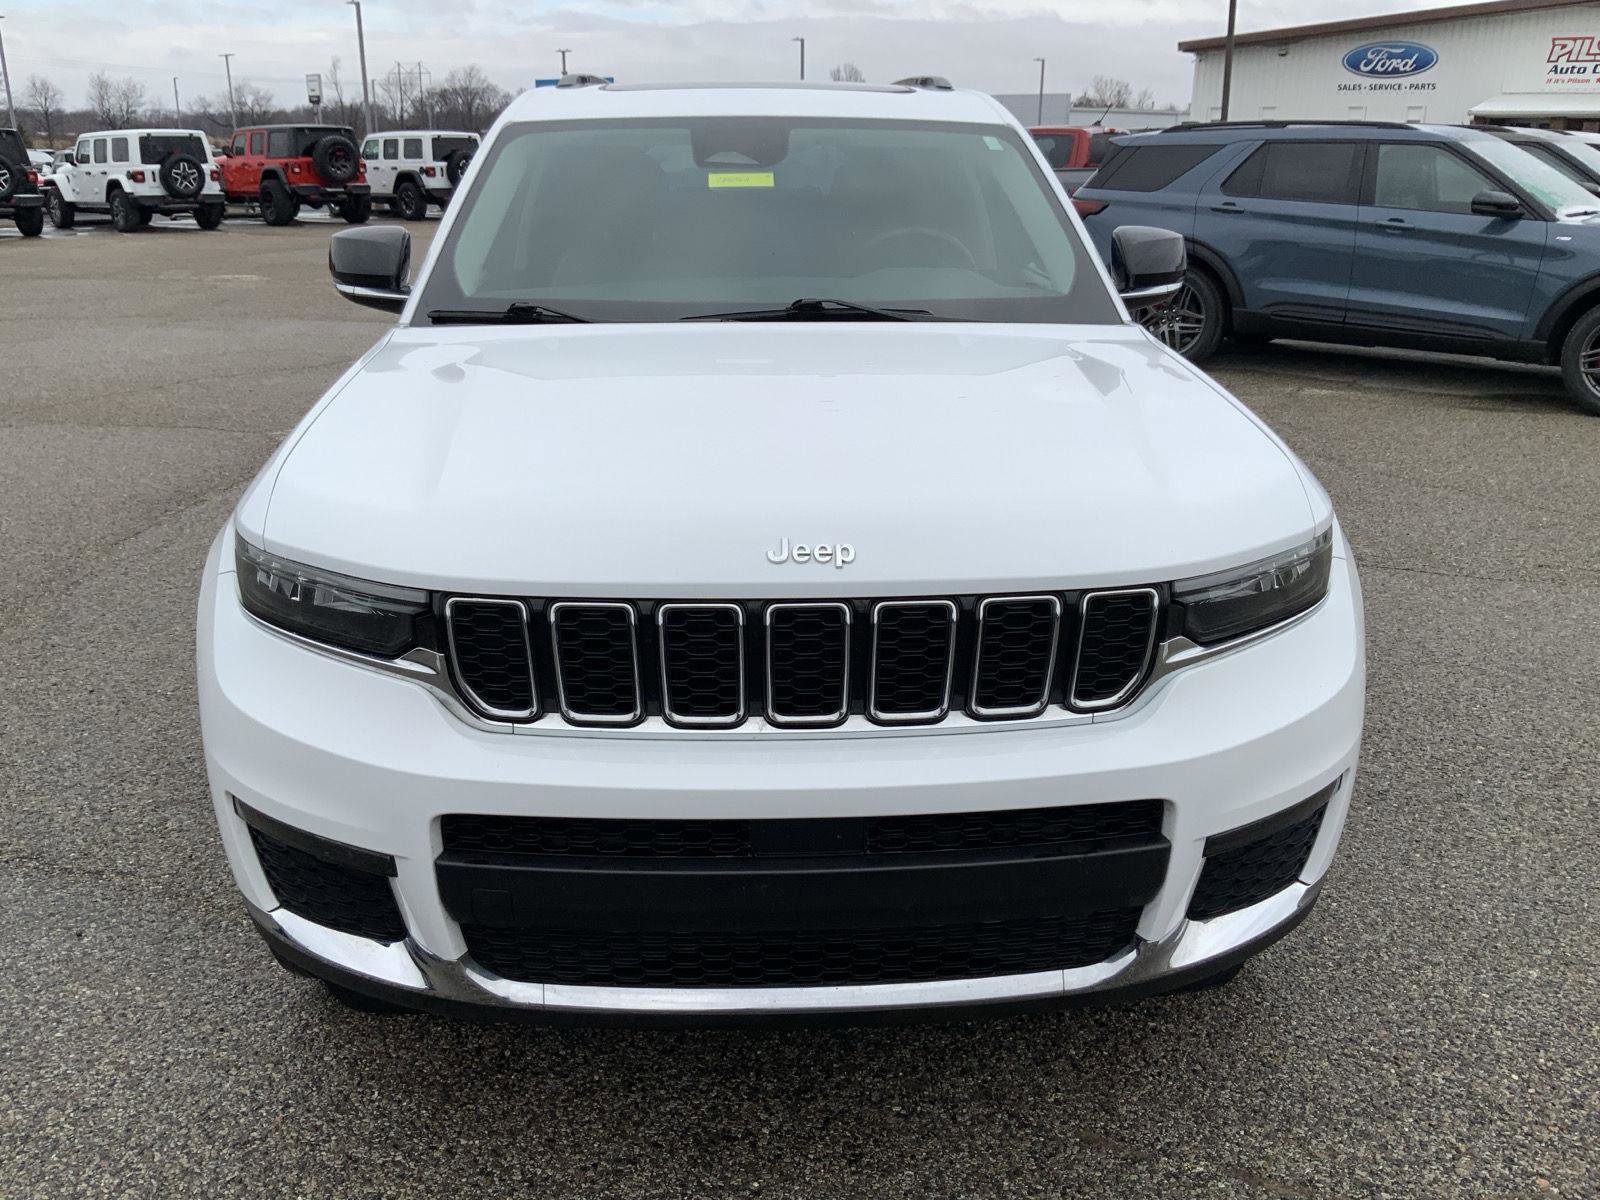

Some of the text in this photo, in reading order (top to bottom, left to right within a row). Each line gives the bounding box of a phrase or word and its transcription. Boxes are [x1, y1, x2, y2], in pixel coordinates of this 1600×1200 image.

[1360, 47, 1419, 72] Ford
[1547, 64, 1587, 75] Auto
[1337, 83, 1437, 92] SALES SERVICE PARTS
[767, 537, 856, 569] Jeep
